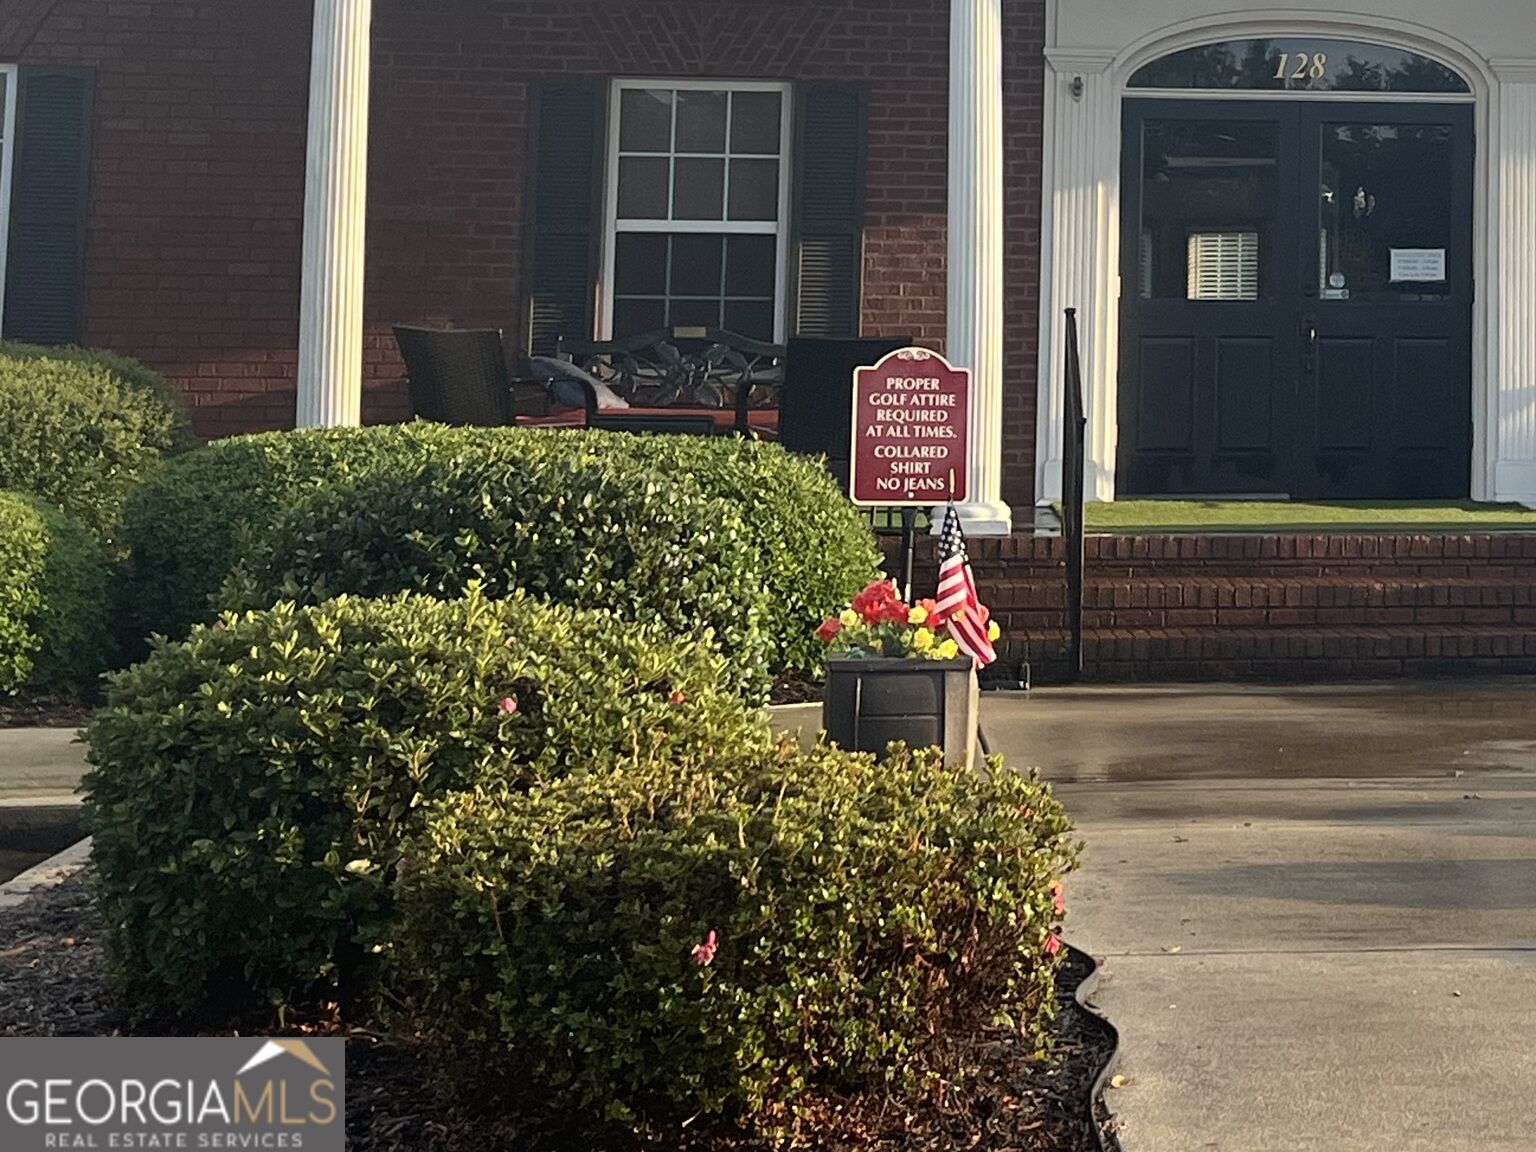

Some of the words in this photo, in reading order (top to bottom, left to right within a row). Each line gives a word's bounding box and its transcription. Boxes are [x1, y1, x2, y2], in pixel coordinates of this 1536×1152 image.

[1273, 53, 1326, 78] 128
[886, 378, 940, 390] PROPER
[869, 393, 907, 406] GOLF
[909, 394, 956, 407] ATTIRE
[876, 410, 948, 423] REQUIRED
[866, 425, 883, 438] AT
[886, 426, 911, 438] ALL
[913, 426, 958, 438] TIMES.
[874, 445, 948, 458] COLLARED
[890, 462, 931, 474] SHIRT
[876, 478, 900, 490] NO
[904, 478, 945, 492] JEANS
